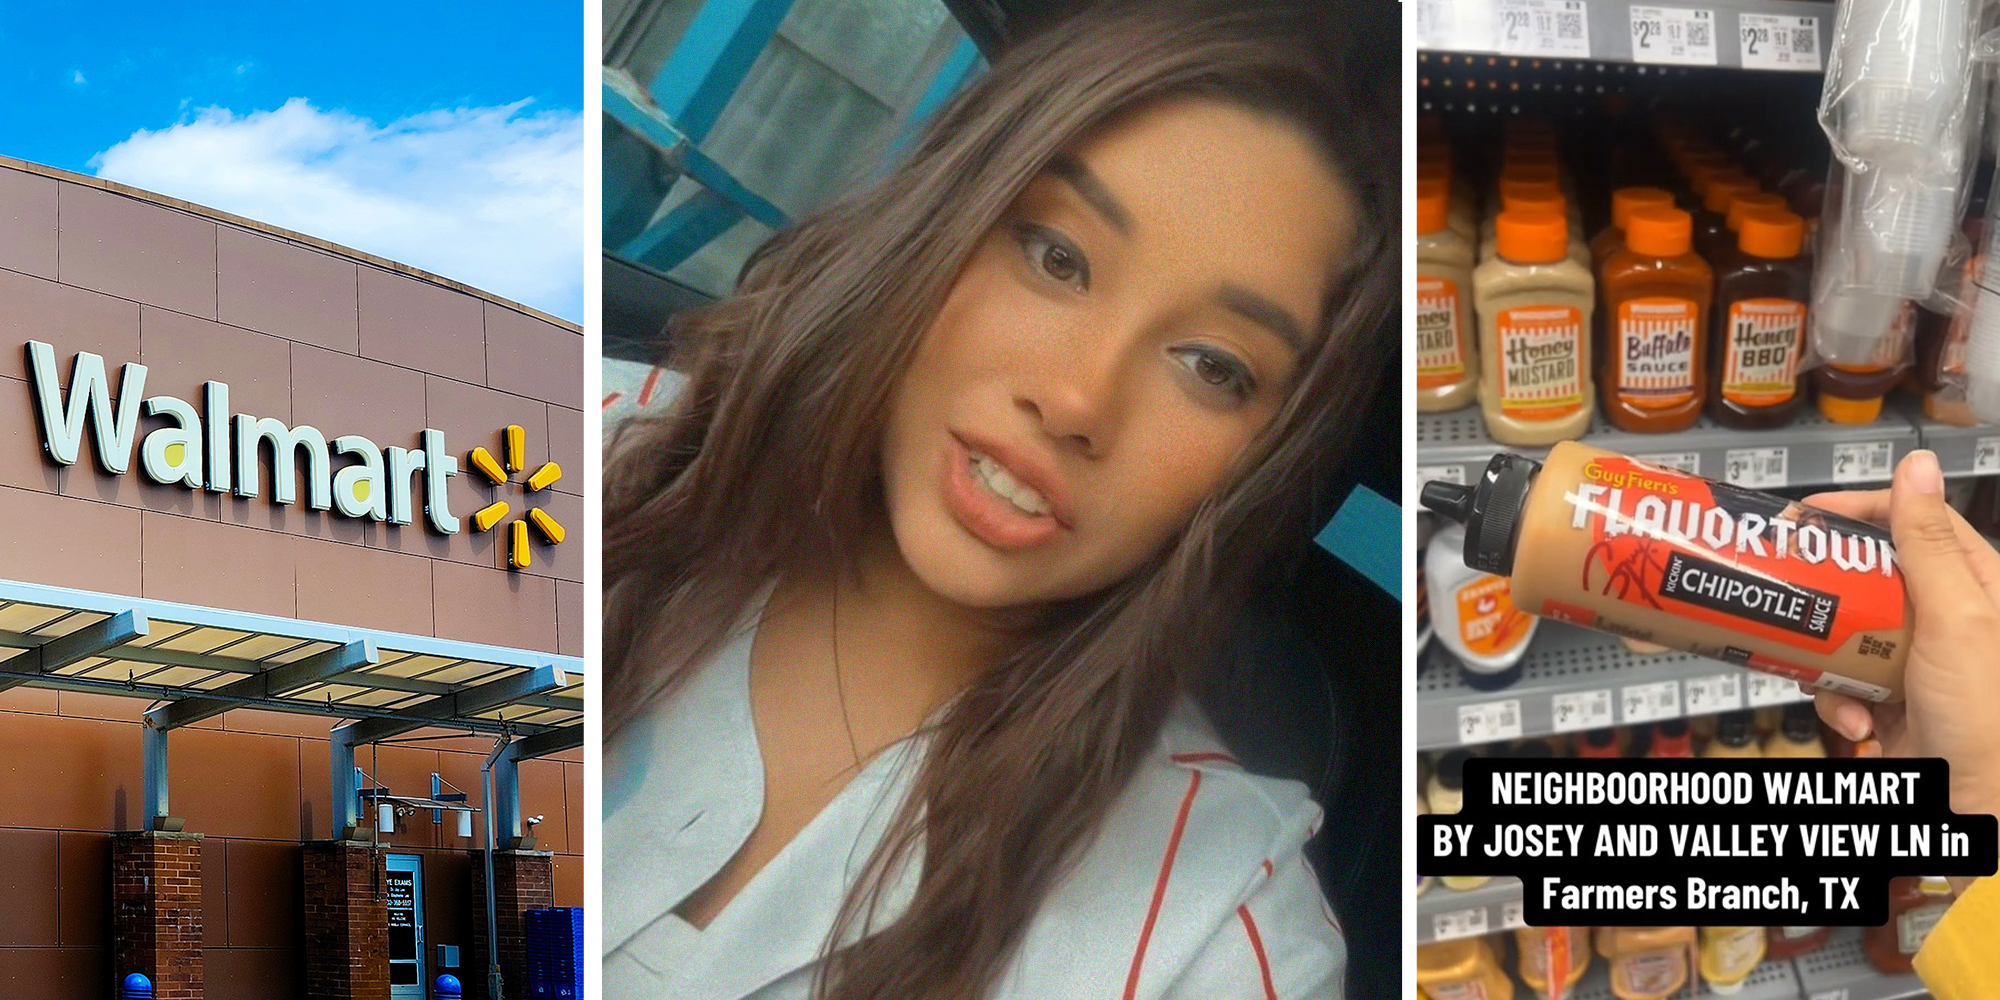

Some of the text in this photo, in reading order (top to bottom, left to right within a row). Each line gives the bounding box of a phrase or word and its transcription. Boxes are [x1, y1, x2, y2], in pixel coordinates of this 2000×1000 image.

[1627, 330, 1690, 361] Buffalo
[1735, 322, 1797, 347] Honey
[1506, 337, 1574, 365] Honey
[1742, 347, 1786, 368] BBQ
[1508, 358, 1574, 387] MUSTARD
[1627, 361, 1688, 372] SAUCE
[25, 339, 460, 535] Walmart
[1584, 462, 1624, 488] Guy
[1682, 568, 1806, 621] CHIPOTLE
[1809, 597, 1832, 633] SAUCE
